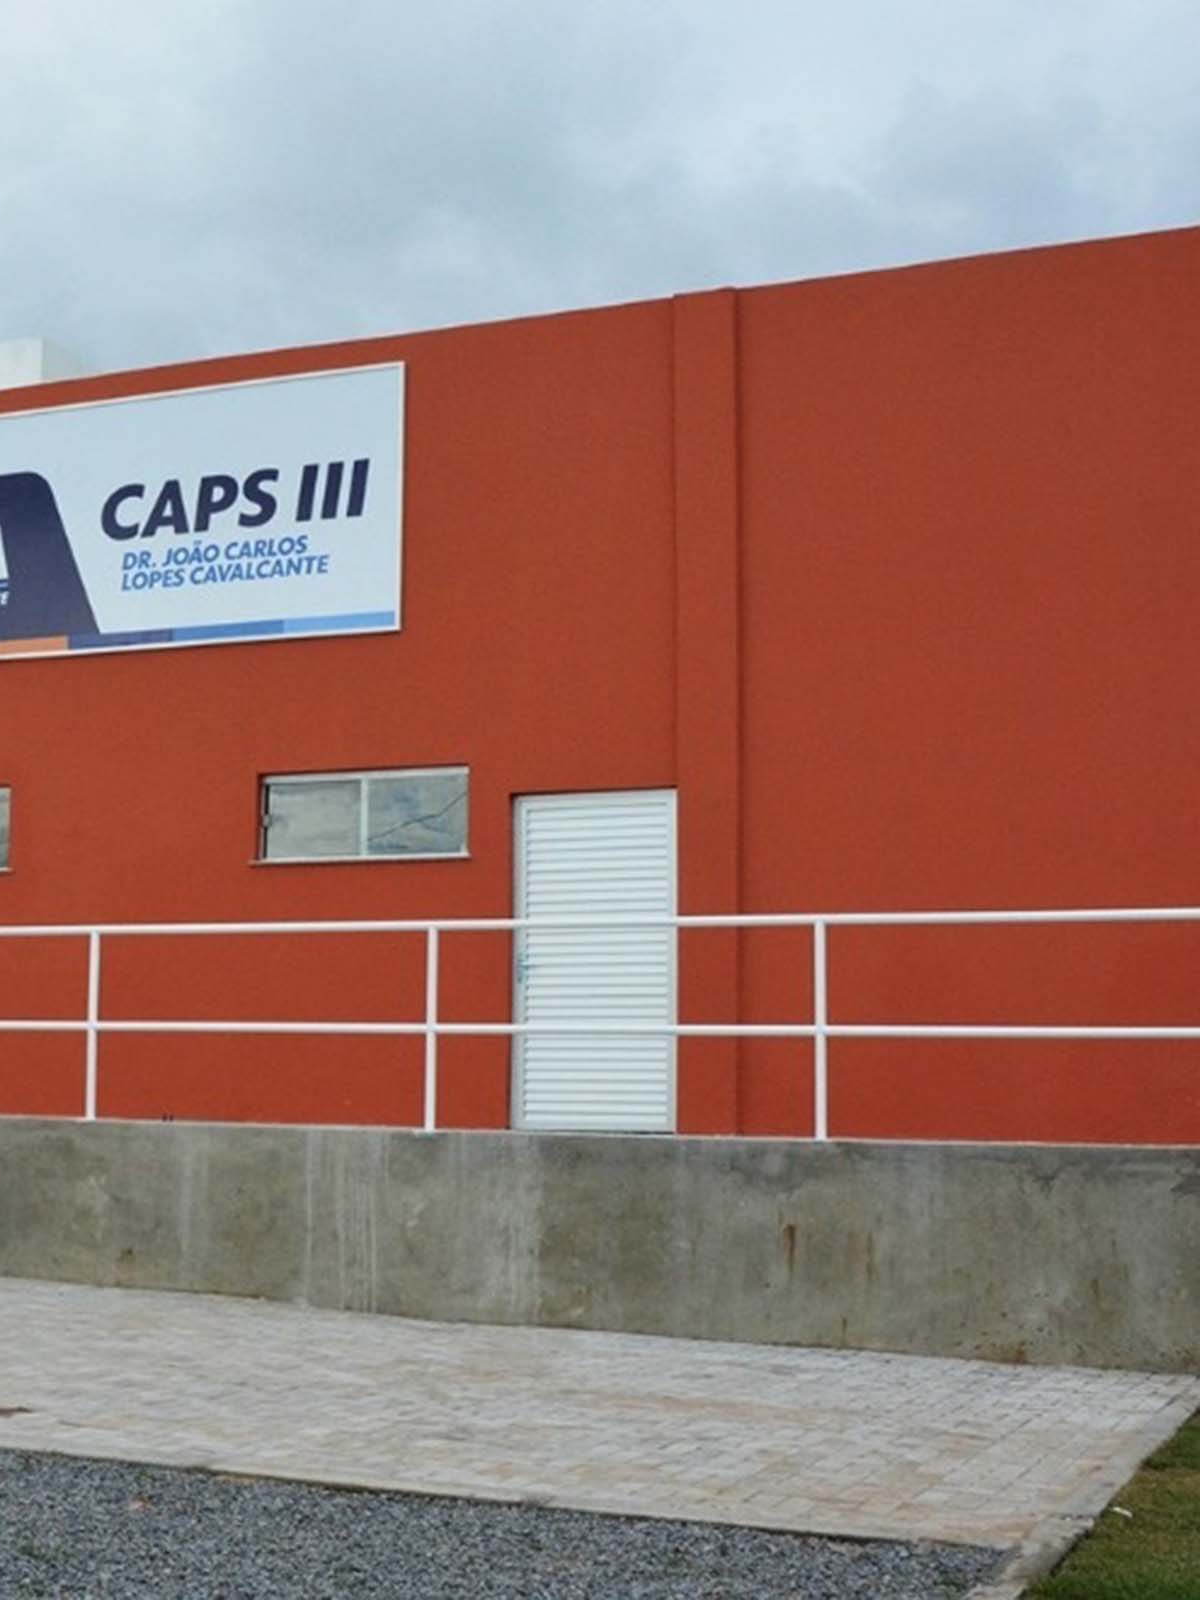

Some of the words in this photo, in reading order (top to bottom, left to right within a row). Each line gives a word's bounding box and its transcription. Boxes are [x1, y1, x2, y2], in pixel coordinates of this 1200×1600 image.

[101, 468, 279, 541] CAPS
[296, 458, 370, 522] III
[122, 551, 156, 570] DR.
[162, 540, 219, 566] JOÃO
[224, 535, 308, 560] CARLOS
[121, 568, 185, 591] LOPES
[190, 554, 329, 585] CAVALCANTE
